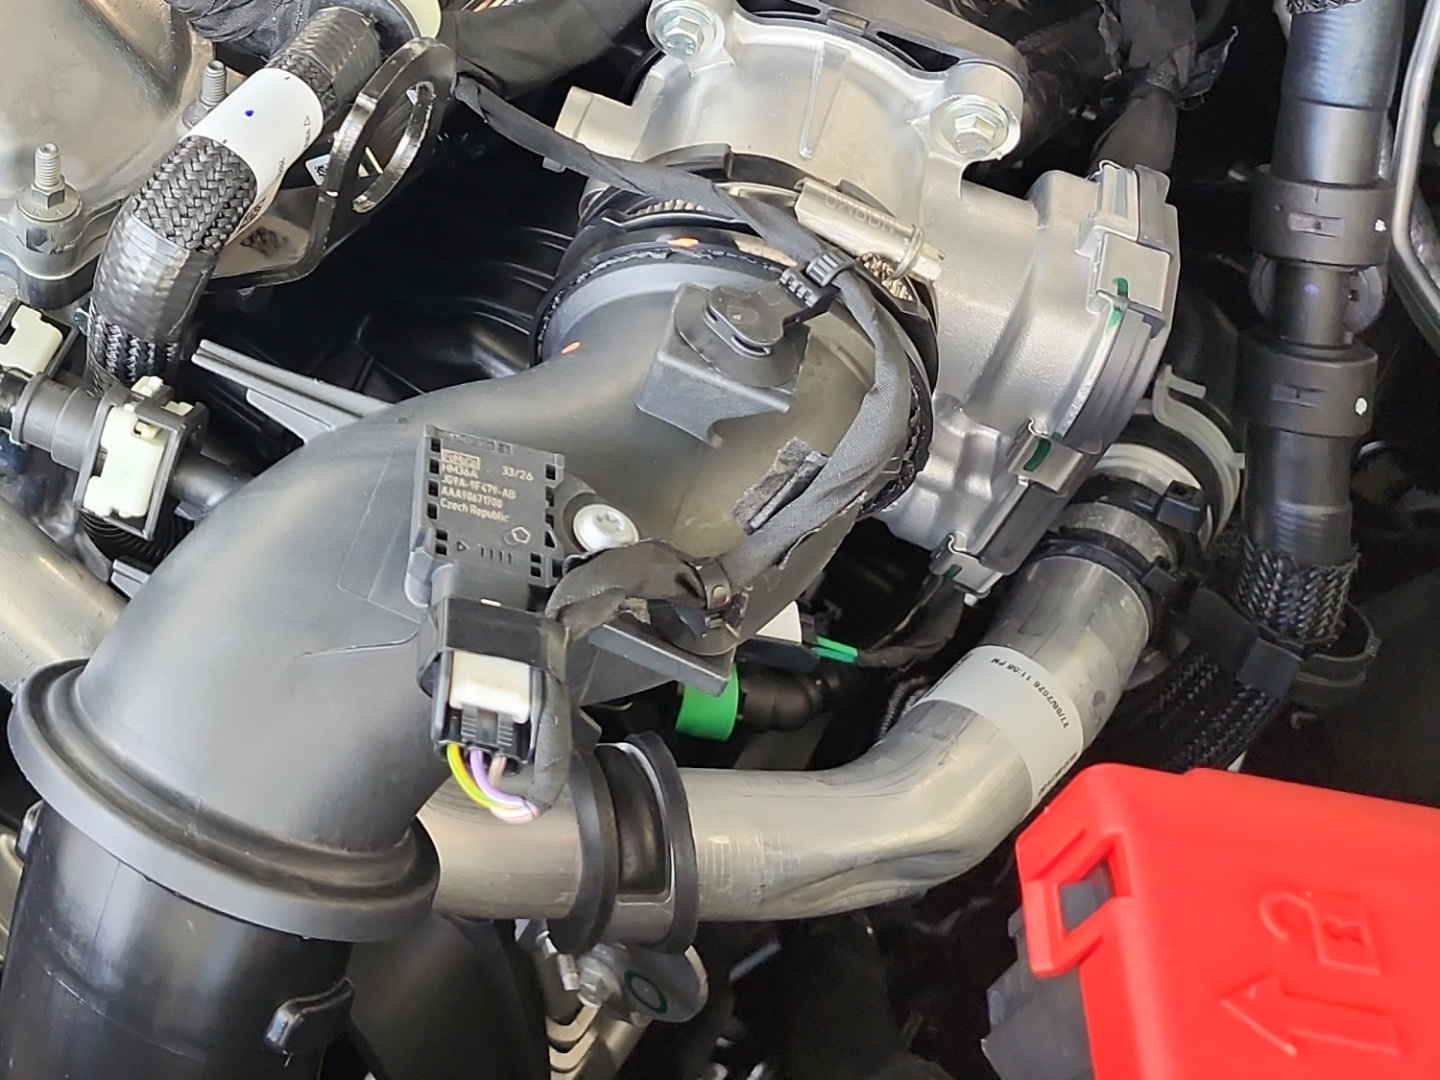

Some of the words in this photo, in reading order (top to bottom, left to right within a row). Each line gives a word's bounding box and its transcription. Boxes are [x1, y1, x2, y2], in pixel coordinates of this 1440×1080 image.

[501, 465, 535, 482] 33/26
[439, 498, 469, 514] Czech
[469, 503, 511, 523] Republic
